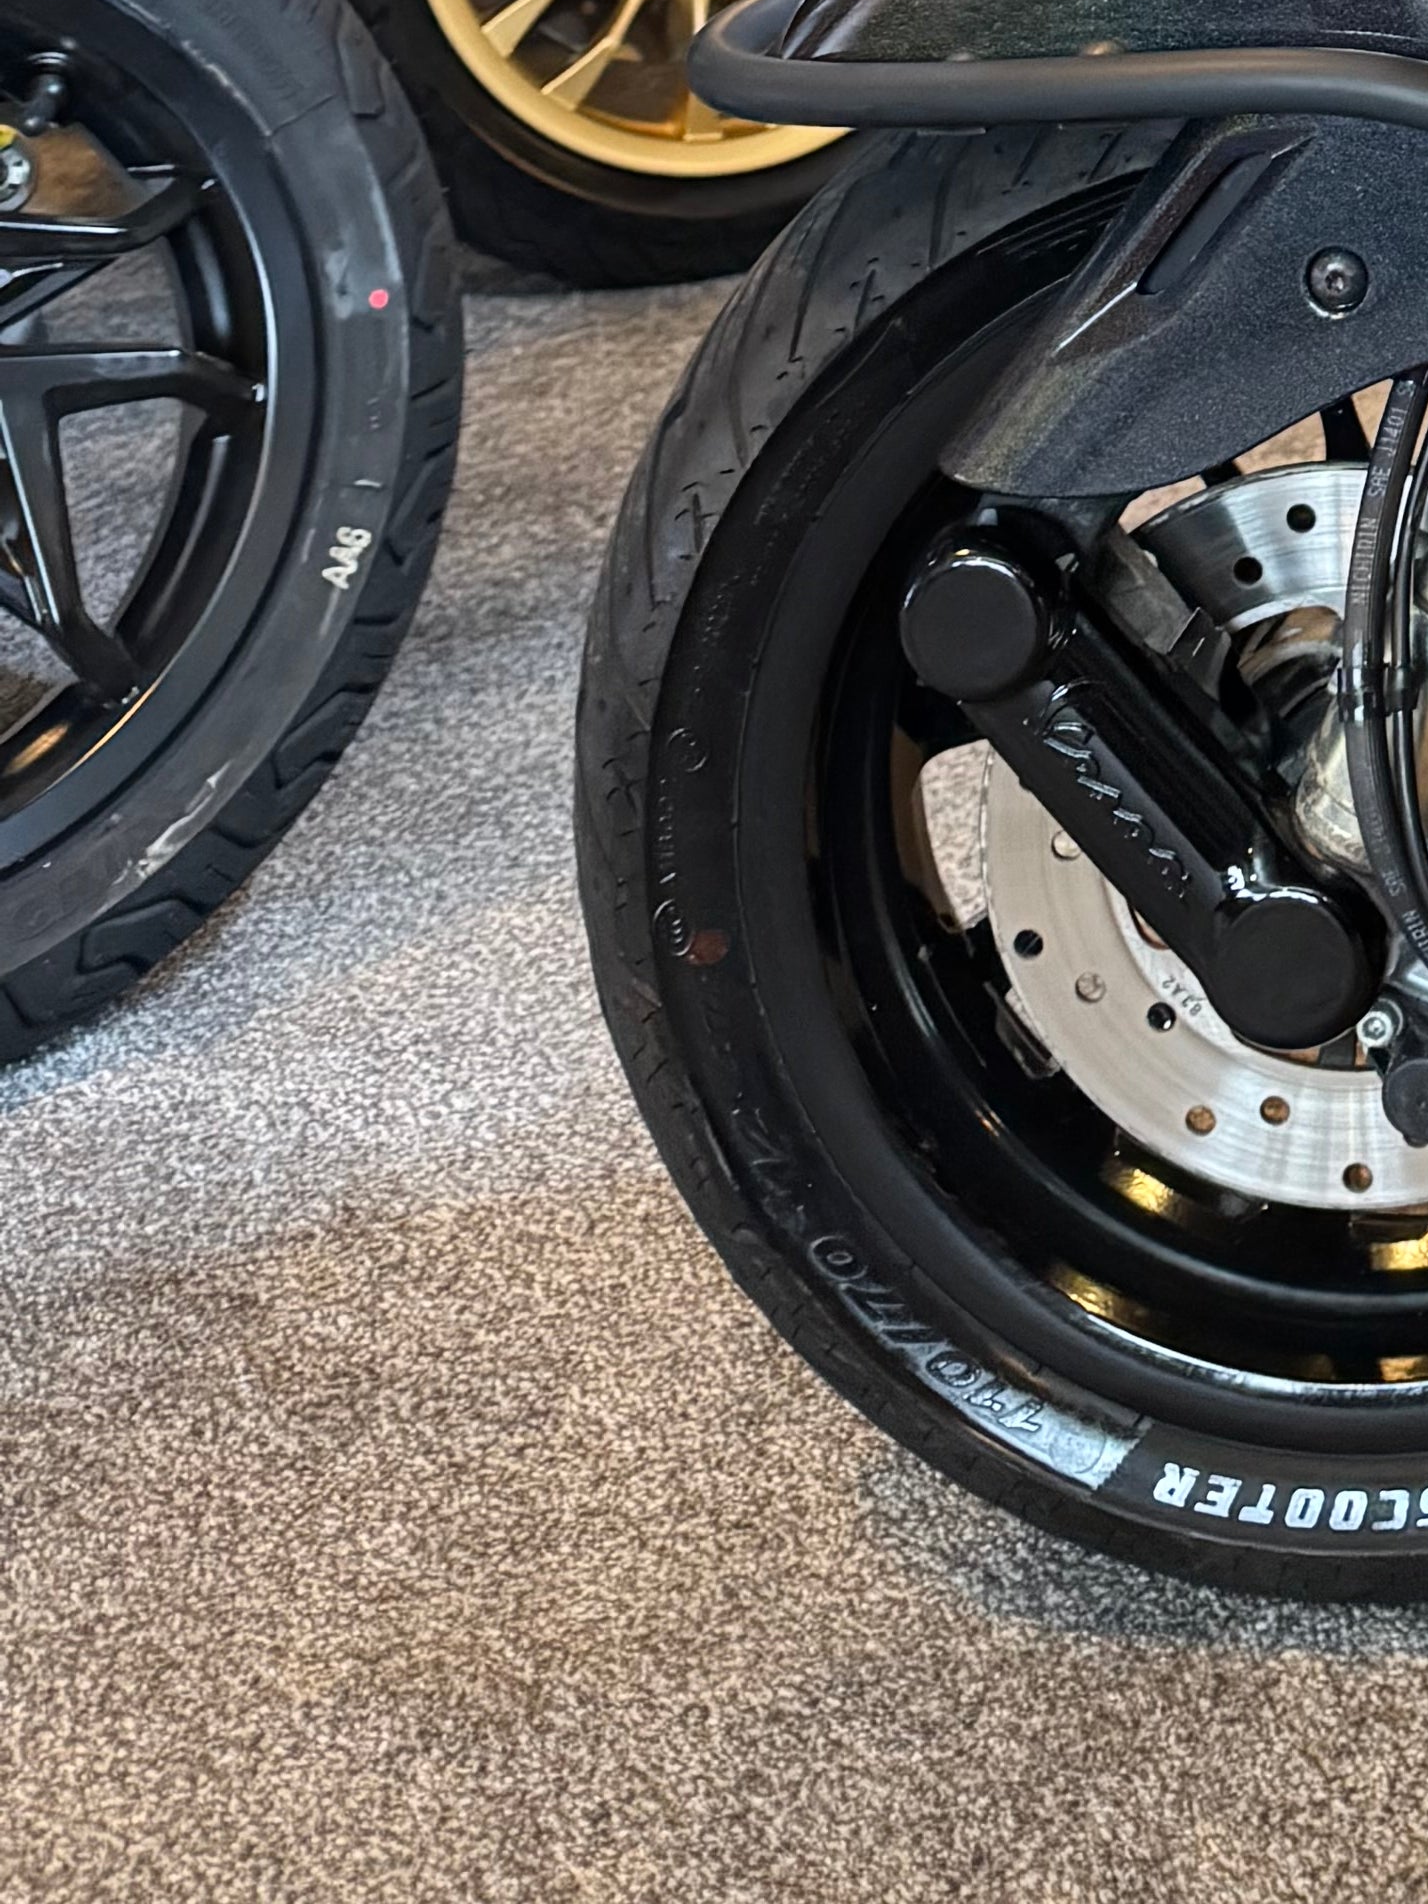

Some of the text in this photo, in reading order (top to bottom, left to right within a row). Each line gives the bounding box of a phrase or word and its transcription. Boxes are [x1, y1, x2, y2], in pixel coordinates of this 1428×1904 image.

[1376, 406, 1408, 457] J1401
[1367, 466, 1391, 497] SAE
[1350, 516, 1379, 605] NICHIRIN
[1380, 869, 1407, 898] SAE
[808, 1233, 1044, 1433] 110/70
